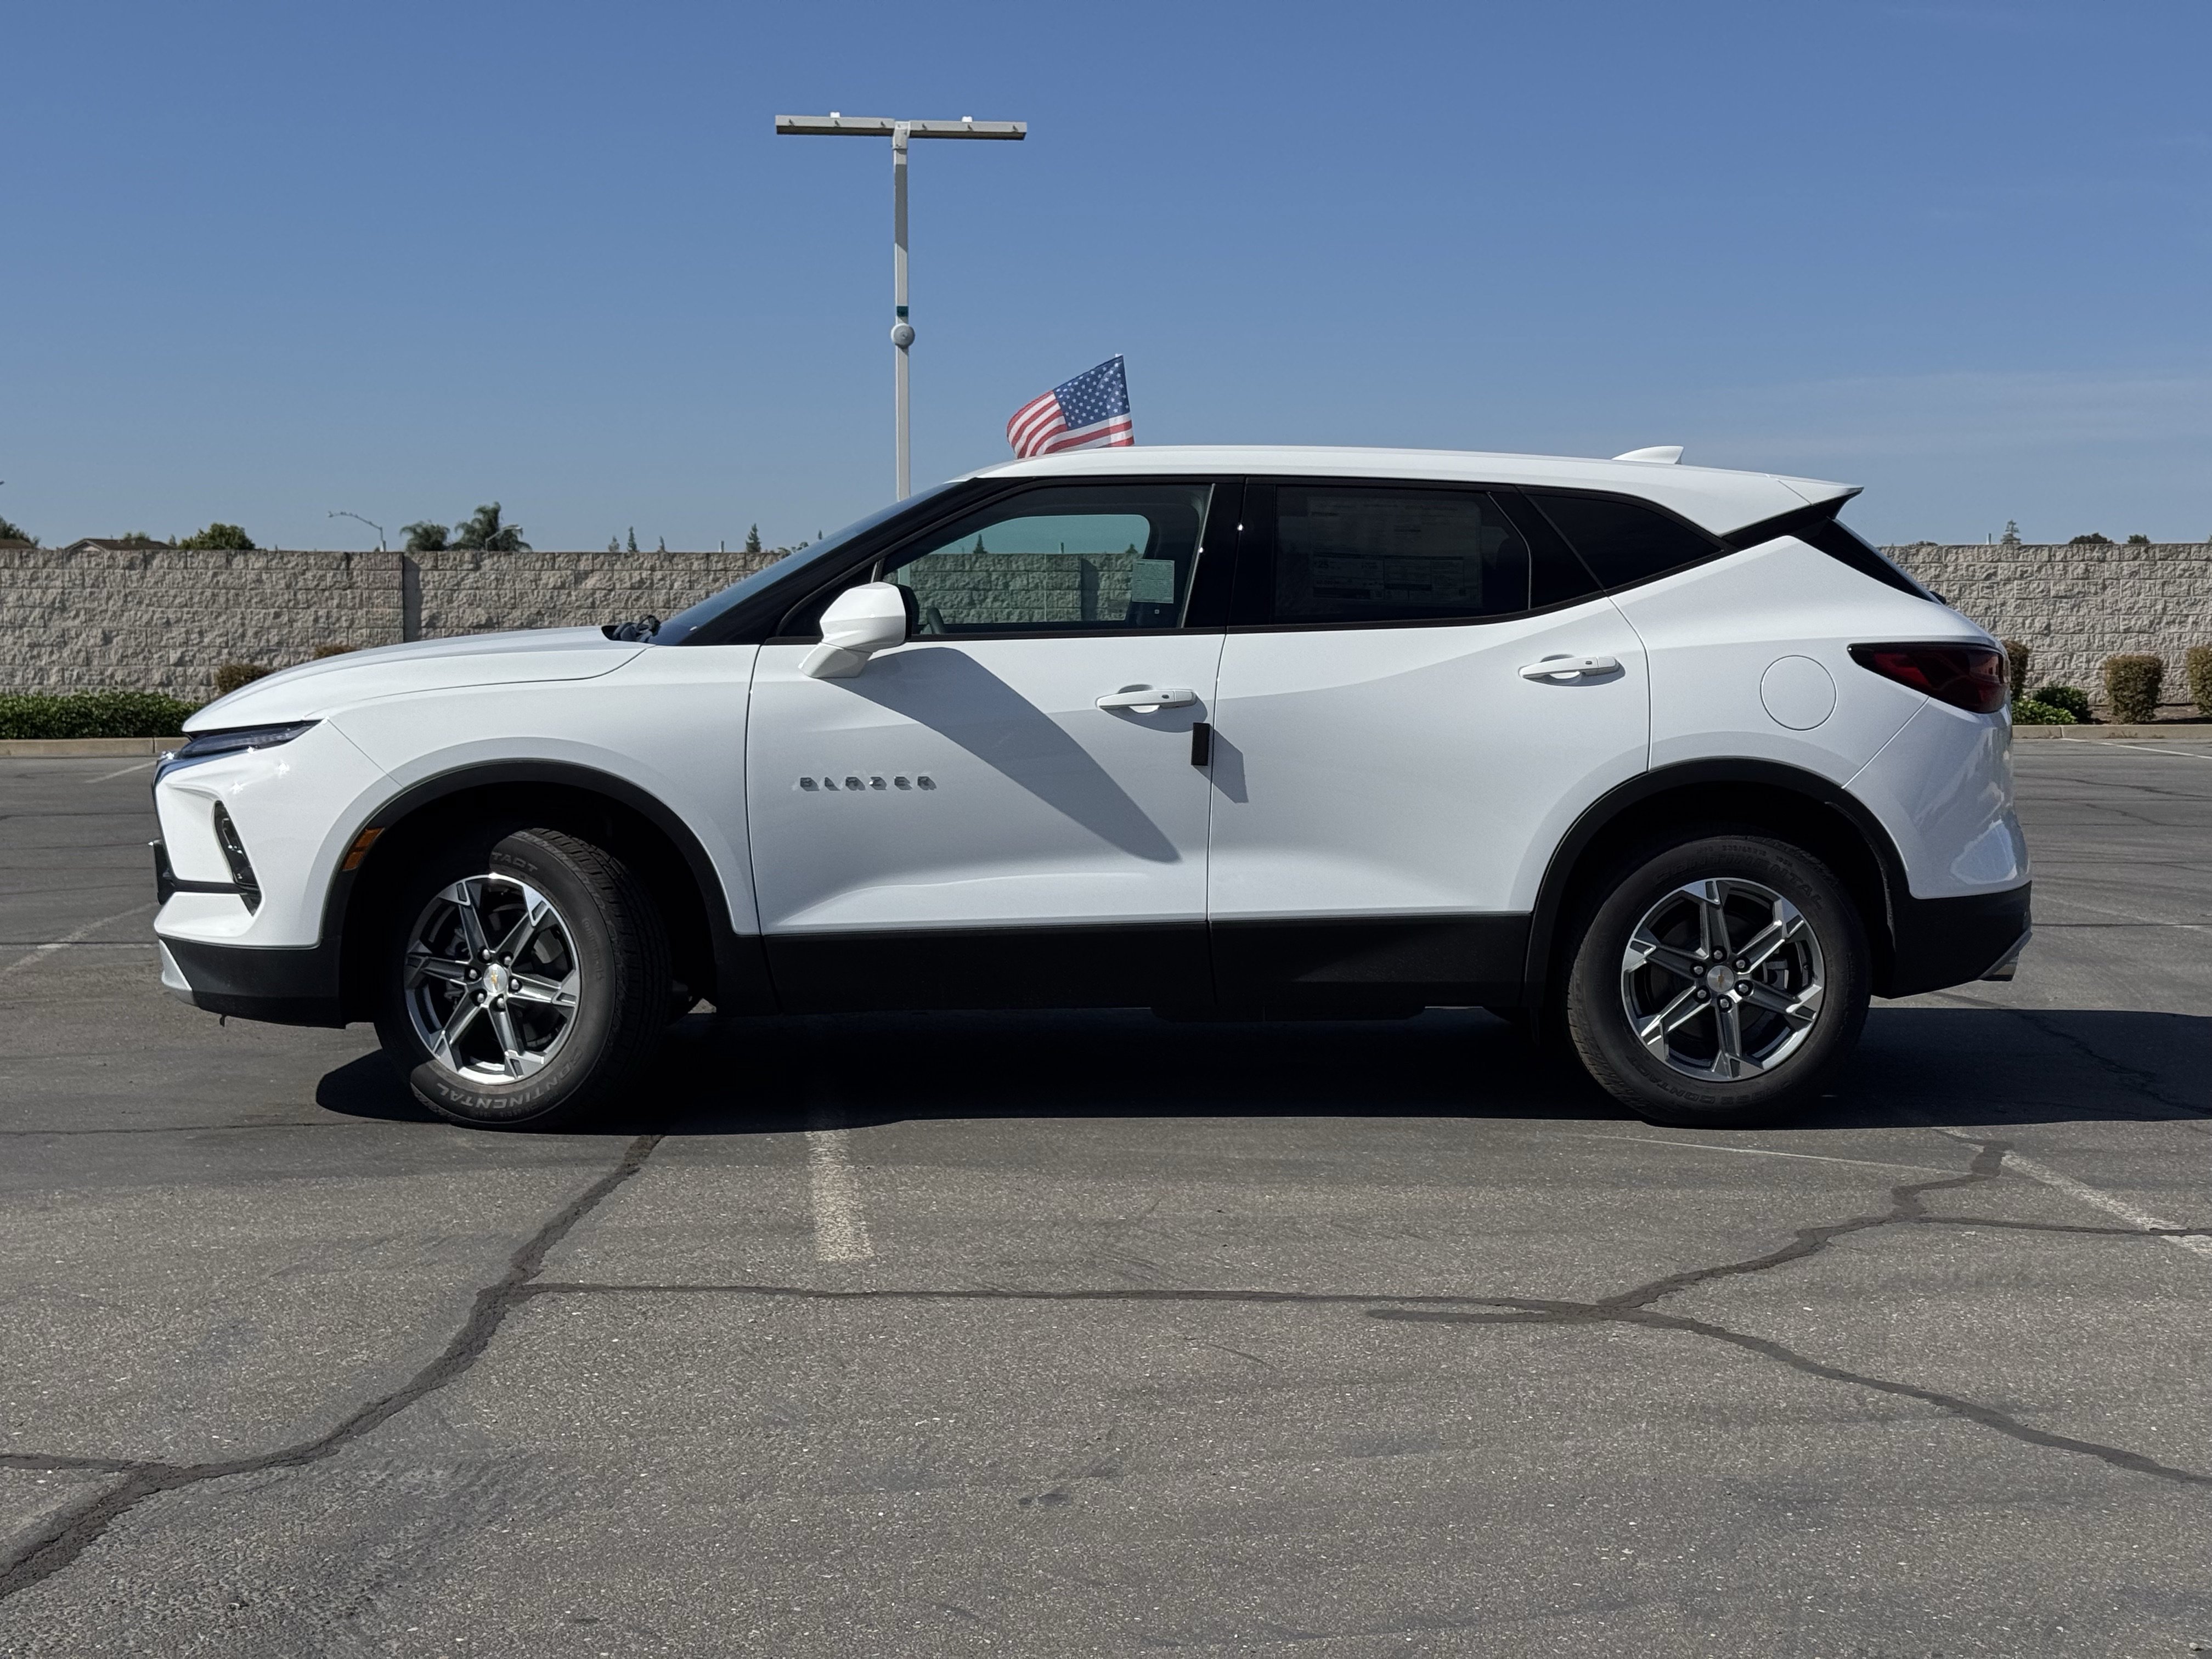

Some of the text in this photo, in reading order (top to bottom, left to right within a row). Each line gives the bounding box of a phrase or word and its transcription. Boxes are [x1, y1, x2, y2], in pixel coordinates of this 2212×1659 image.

[799, 776, 934, 789] BLAZER
[491, 851, 539, 872] TACT
[437, 1047, 583, 1109] CONTINENTAL
